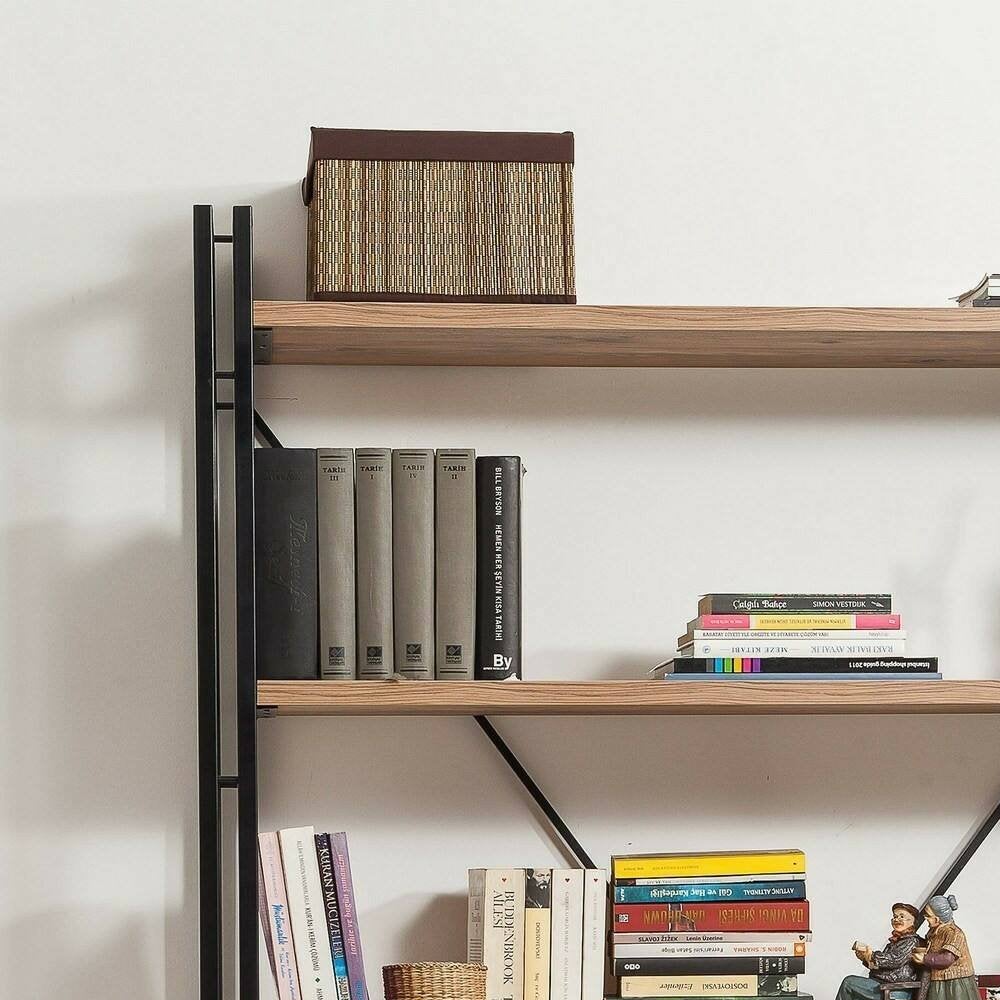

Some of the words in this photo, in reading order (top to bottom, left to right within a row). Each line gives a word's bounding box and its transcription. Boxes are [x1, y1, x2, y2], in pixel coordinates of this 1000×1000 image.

[494, 467, 502, 485] BILL
[494, 486, 502, 516] BRYSON
[494, 524, 502, 552] HEMEN
[494, 553, 502, 570] HER
[494, 596, 503, 614] KISA
[812, 600, 836, 608] SIMON
[493, 653, 512, 671] By
[864, 660, 880, 669] guide
[719, 889, 732, 897] Gül
[771, 887, 795, 895] AYTUNÇ
[348, 929, 357, 955] tarihte
[504, 890, 515, 985] BUDDENBROOK
